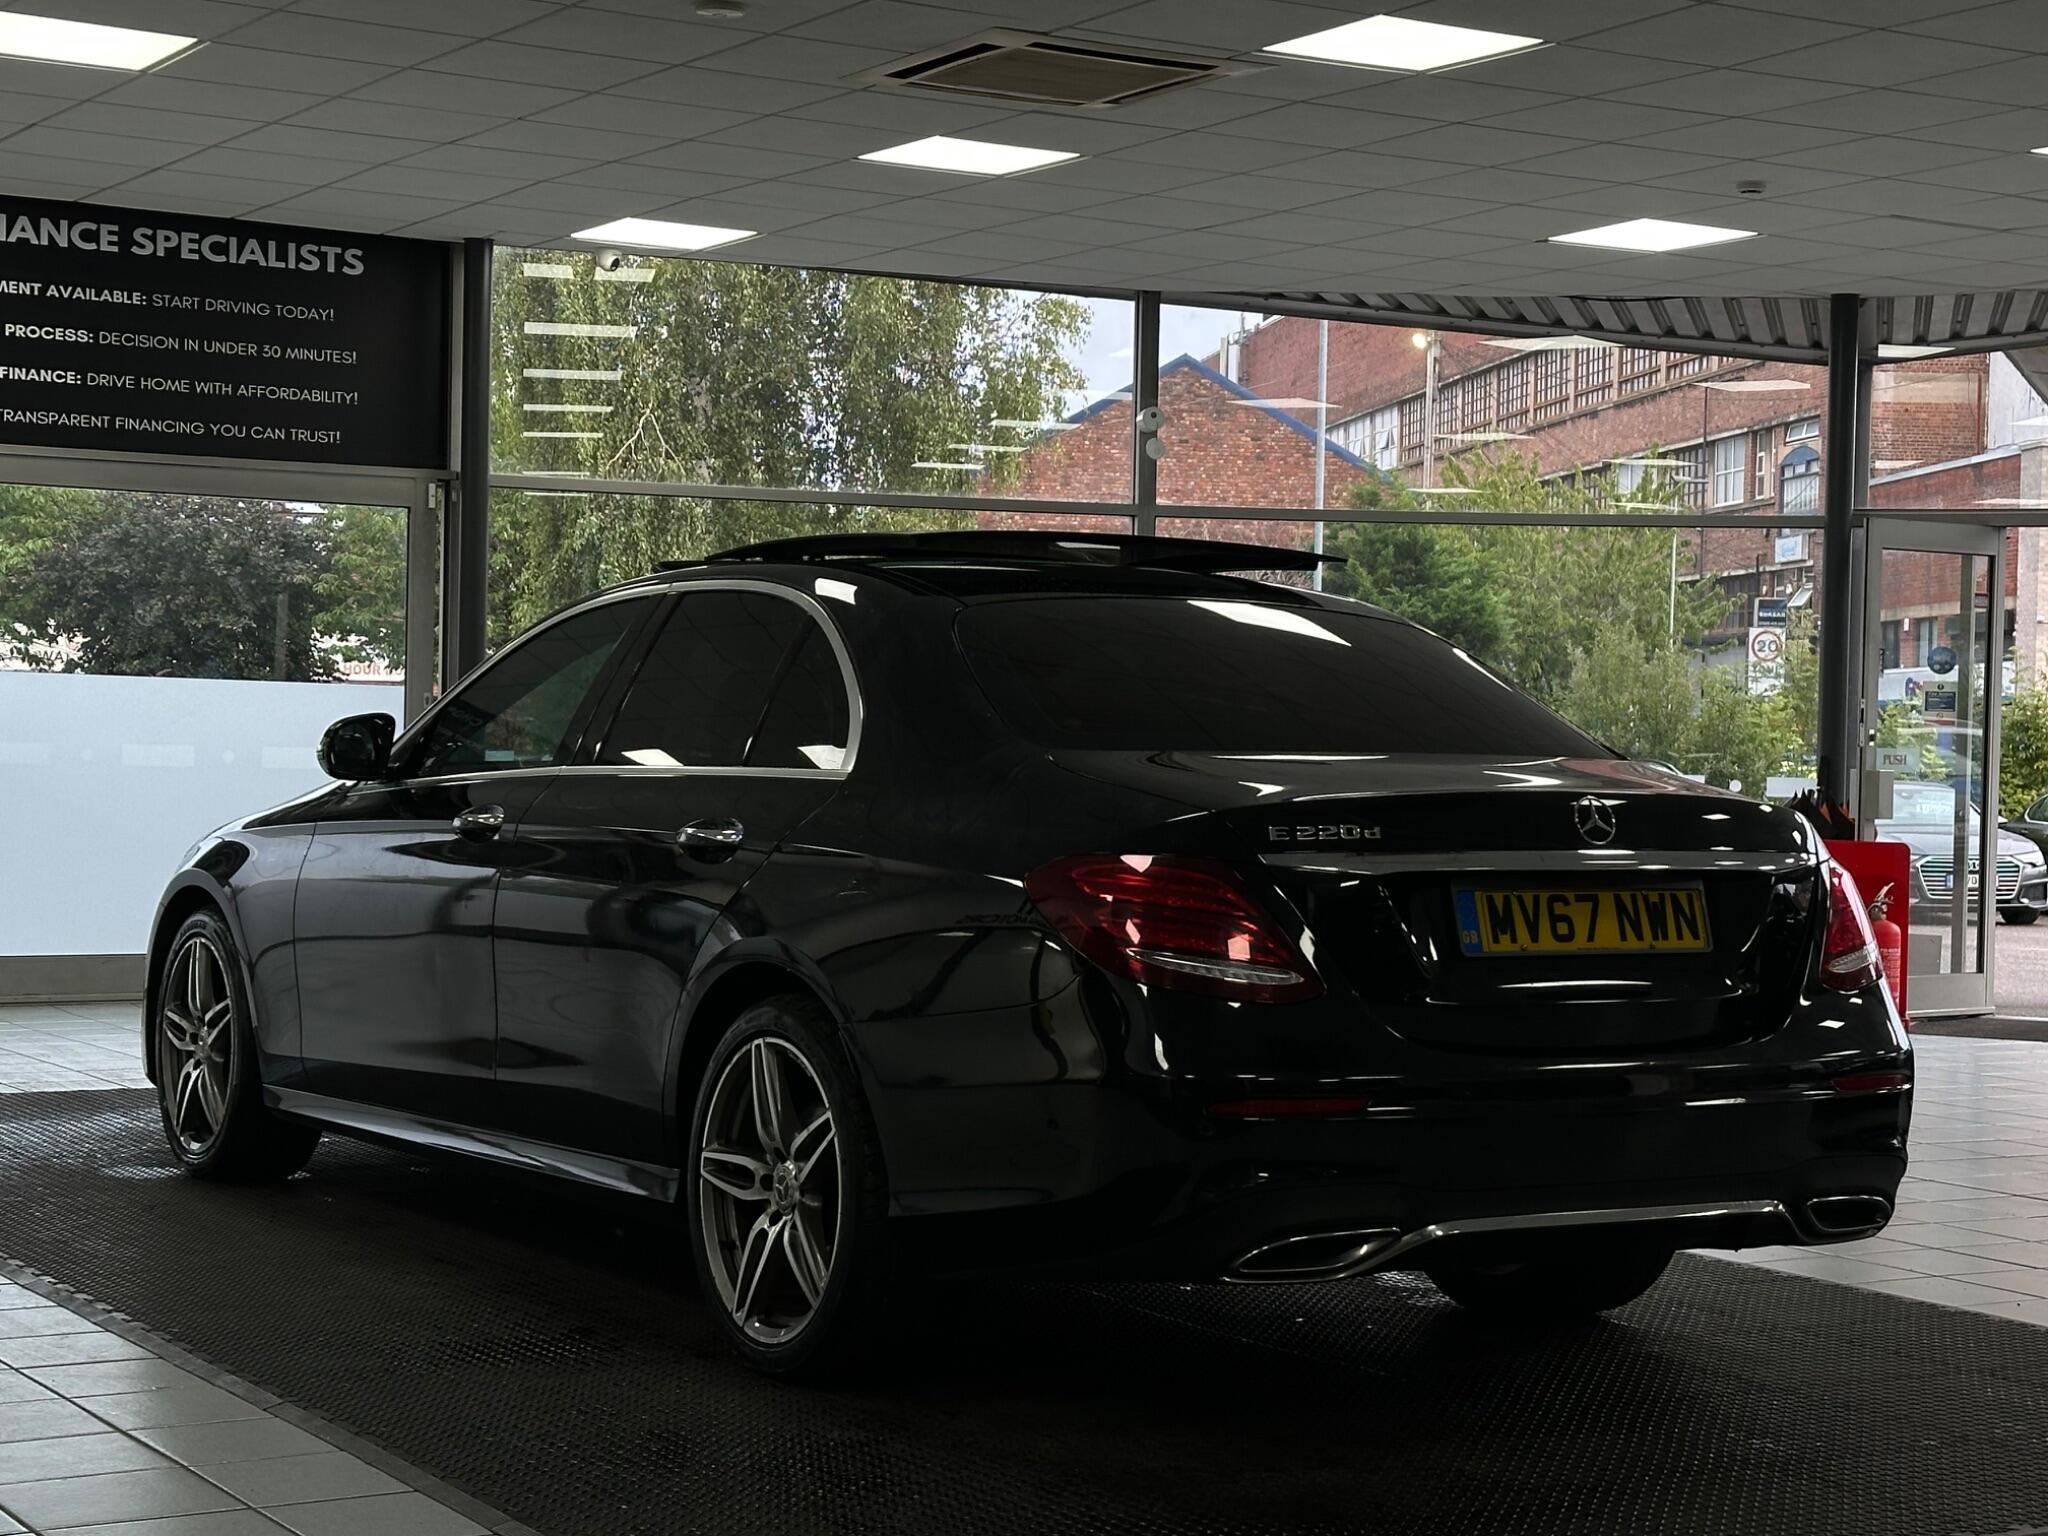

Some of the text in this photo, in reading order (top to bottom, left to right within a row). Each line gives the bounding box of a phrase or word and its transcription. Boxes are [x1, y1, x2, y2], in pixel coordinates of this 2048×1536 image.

[0, 213, 364, 275] ANCE SPECIALISTS
[46, 285, 147, 305] AVAILABLE:
[152, 294, 200, 310] START
[205, 298, 270, 316] DRIVING
[275, 304, 334, 322] TODAY!
[5, 324, 357, 365] PROCESS: DECISION IN UNDER 30 MINUTES!
[87, 372, 135, 389] DRIVE
[140, 377, 190, 392] HOME
[195, 381, 232, 395] WITH
[236, 384, 358, 405] AFFORDABILITY!
[115, 417, 205, 435] FINANCING
[210, 424, 246, 437] YOU
[251, 426, 285, 440] CAN
[290, 428, 340, 443] TRUST!
[1757, 640, 1778, 653] 20
[343, 663, 380, 676] HOUR
[1883, 754, 1907, 766] PUSH
[1268, 824, 1381, 840] E 220d
[1485, 892, 1700, 944] MV67 NWN
